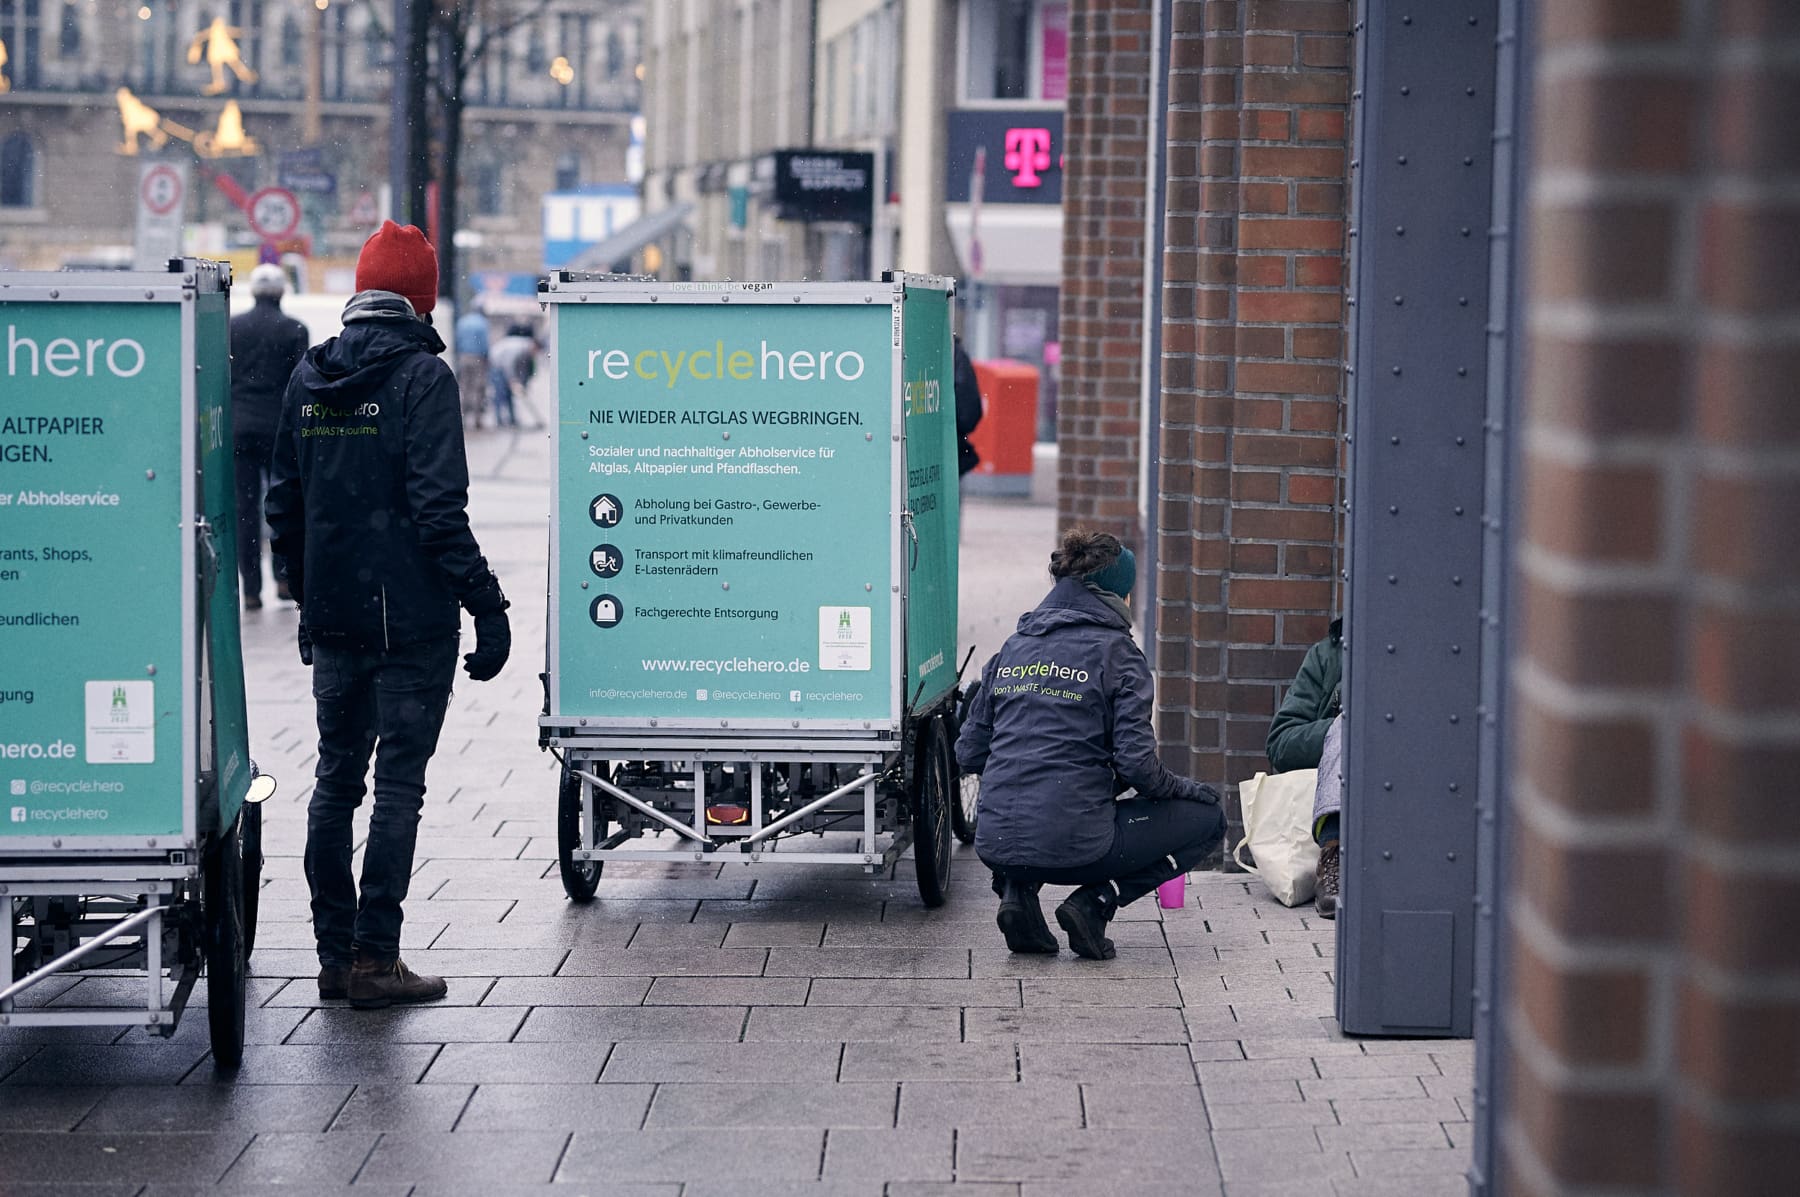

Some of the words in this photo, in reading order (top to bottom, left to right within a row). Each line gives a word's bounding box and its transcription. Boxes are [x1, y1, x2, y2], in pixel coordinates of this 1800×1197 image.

[742, 282, 773, 293] vegan
[8, 324, 145, 377] hero
[588, 340, 865, 389] recyclehero
[589, 410, 614, 424] NIE
[618, 410, 677, 424] WIEDER
[680, 410, 747, 425] ALTGLAS
[752, 411, 863, 425] WEGBRINGEN.
[2, 416, 104, 435] ALTPAPIER
[0, 444, 53, 462] GEN.
[589, 445, 634, 457] Sozialer
[637, 446, 660, 457] und
[663, 446, 735, 460] nachhaltiger
[739, 446, 816, 458] Abholservice
[819, 447, 836, 458] für
[589, 461, 631, 475] Altglas,
[634, 462, 687, 476] Altpapier
[690, 462, 713, 474] und
[716, 463, 801, 475] Pfandflaschen.
[17, 490, 120, 506] Abholservice
[635, 499, 690, 511] Abholung
[694, 499, 712, 510] bei
[714, 500, 760, 511] Gastro-,
[763, 500, 821, 511] Gewerbe-
[635, 514, 657, 525] und
[660, 515, 734, 525] Privatkunden
[43, 546, 93, 564] Shops,
[635, 549, 688, 562] Transport
[692, 550, 710, 560] mit
[712, 550, 813, 561] klimafreundlichen
[635, 565, 718, 576] E-Lastenrädern
[635, 607, 711, 618] Fachgerechte
[714, 608, 778, 620] Entsorgung
[641, 657, 810, 675] www.recyclehero.de
[996, 660, 1089, 683] recyclehero
[589, 688, 688, 700] info@recyclehero.de
[712, 690, 781, 702] @recycle.hero
[806, 691, 863, 702] recyclehero
[994, 684, 1011, 696] Don't
[1013, 683, 1039, 693] WASTE
[1040, 687, 1061, 697] your
[1062, 689, 1083, 701] time
[30, 780, 124, 796] @recycle.hero
[31, 806, 109, 821] recyclehero
